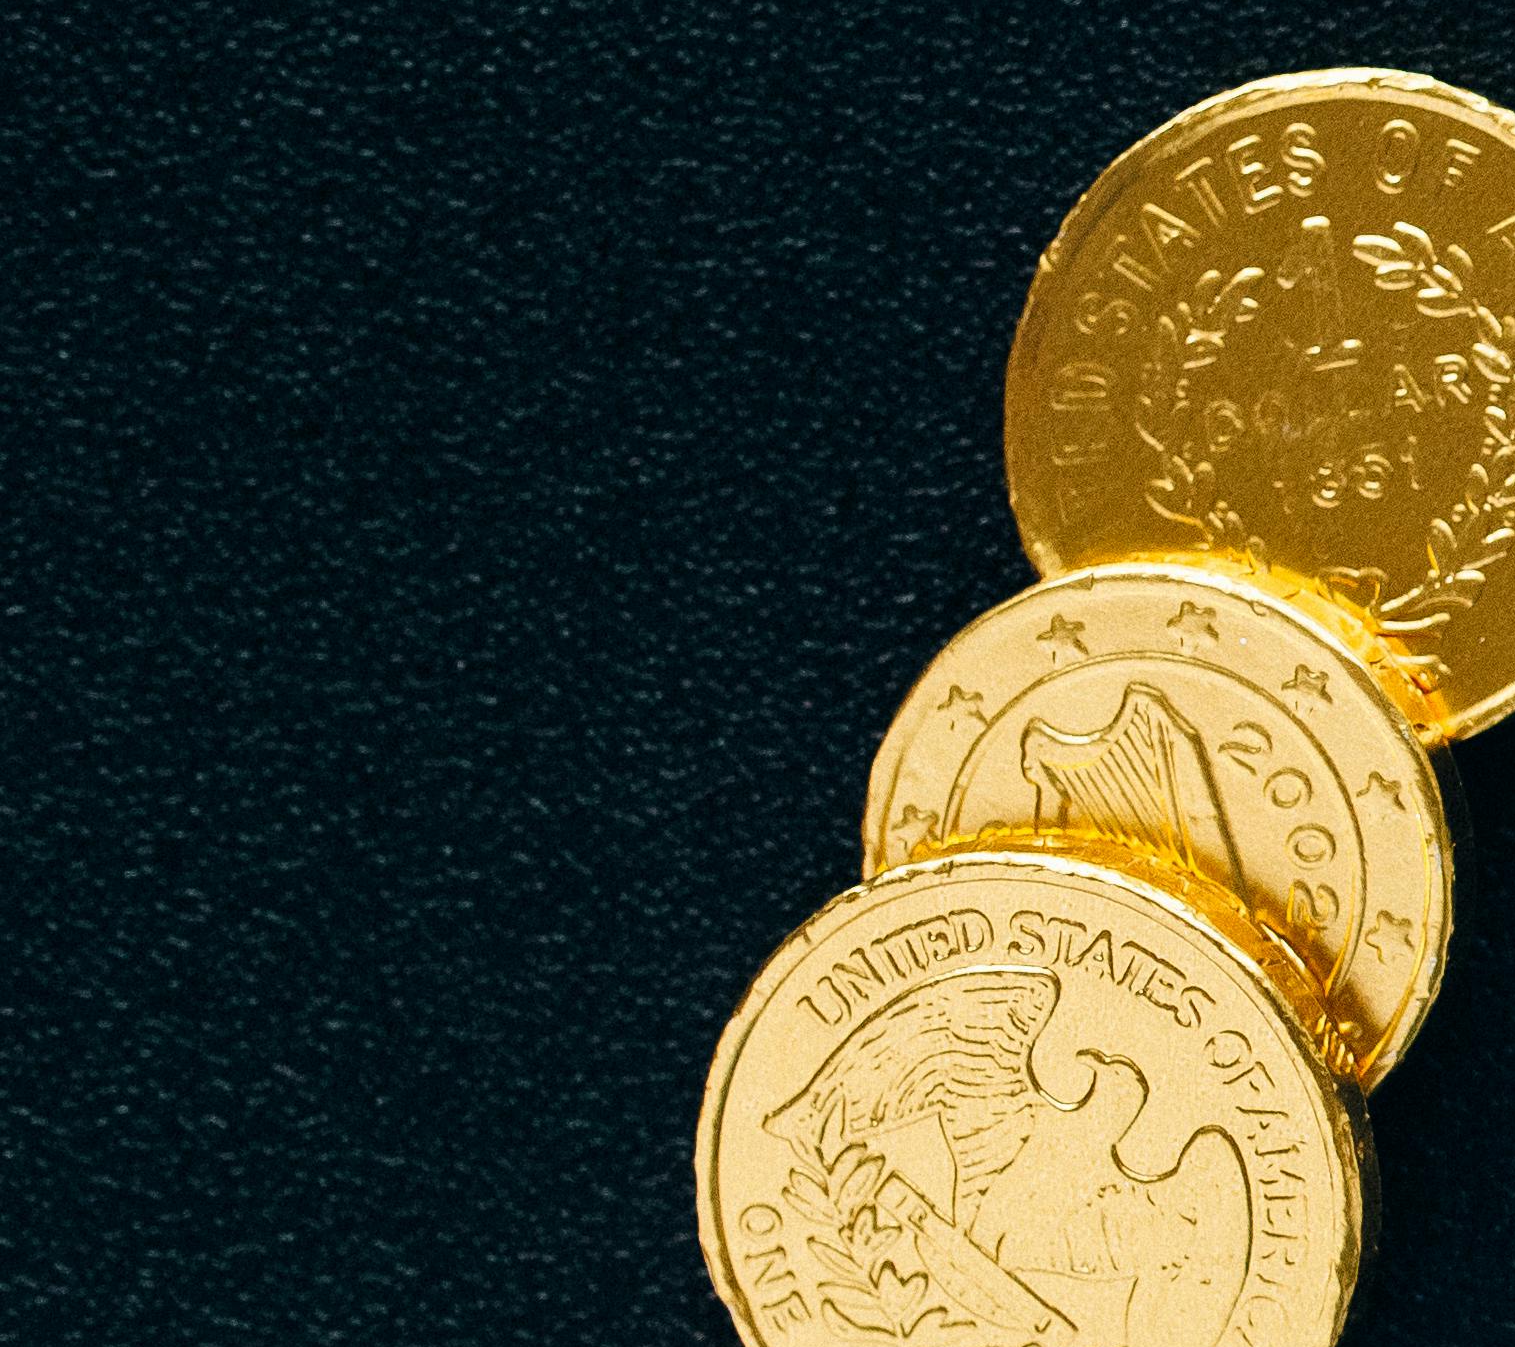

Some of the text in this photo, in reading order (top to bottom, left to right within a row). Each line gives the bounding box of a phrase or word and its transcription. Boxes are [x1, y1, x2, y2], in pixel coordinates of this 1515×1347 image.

[1074, 121, 1326, 336] STATES
[1376, 118, 1482, 195] OF
[1216, 720, 1341, 940] 2002
[796, 907, 994, 1027] UNITED
[1008, 908, 1217, 1031] STATES
[1203, 1028, 1278, 1090] OF
[738, 1200, 813, 1336] ONE
